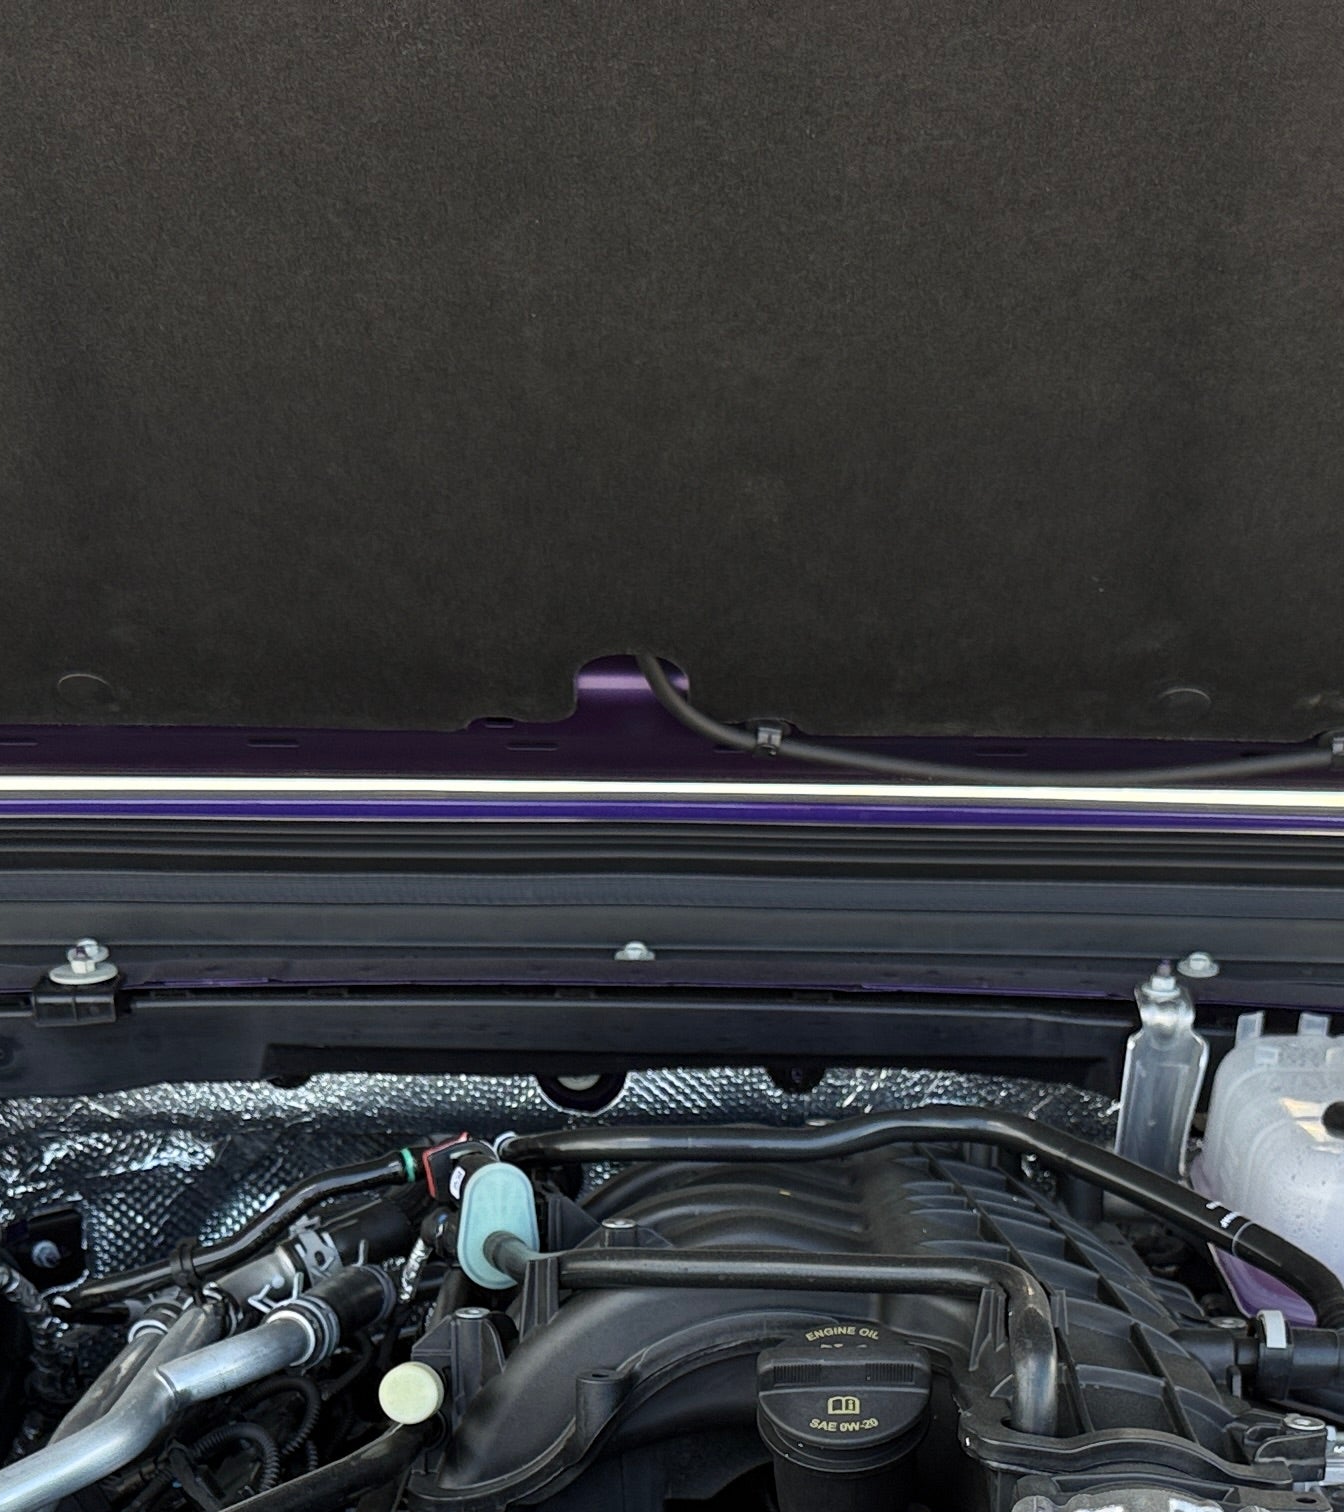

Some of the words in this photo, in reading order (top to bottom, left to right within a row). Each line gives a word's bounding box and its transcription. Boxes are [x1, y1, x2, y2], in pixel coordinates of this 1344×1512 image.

[805, 1326, 856, 1341] ENGINE
[859, 1328, 879, 1340] OIL
[809, 1418, 837, 1432] SAE
[839, 1418, 879, 1432] 0W-20
